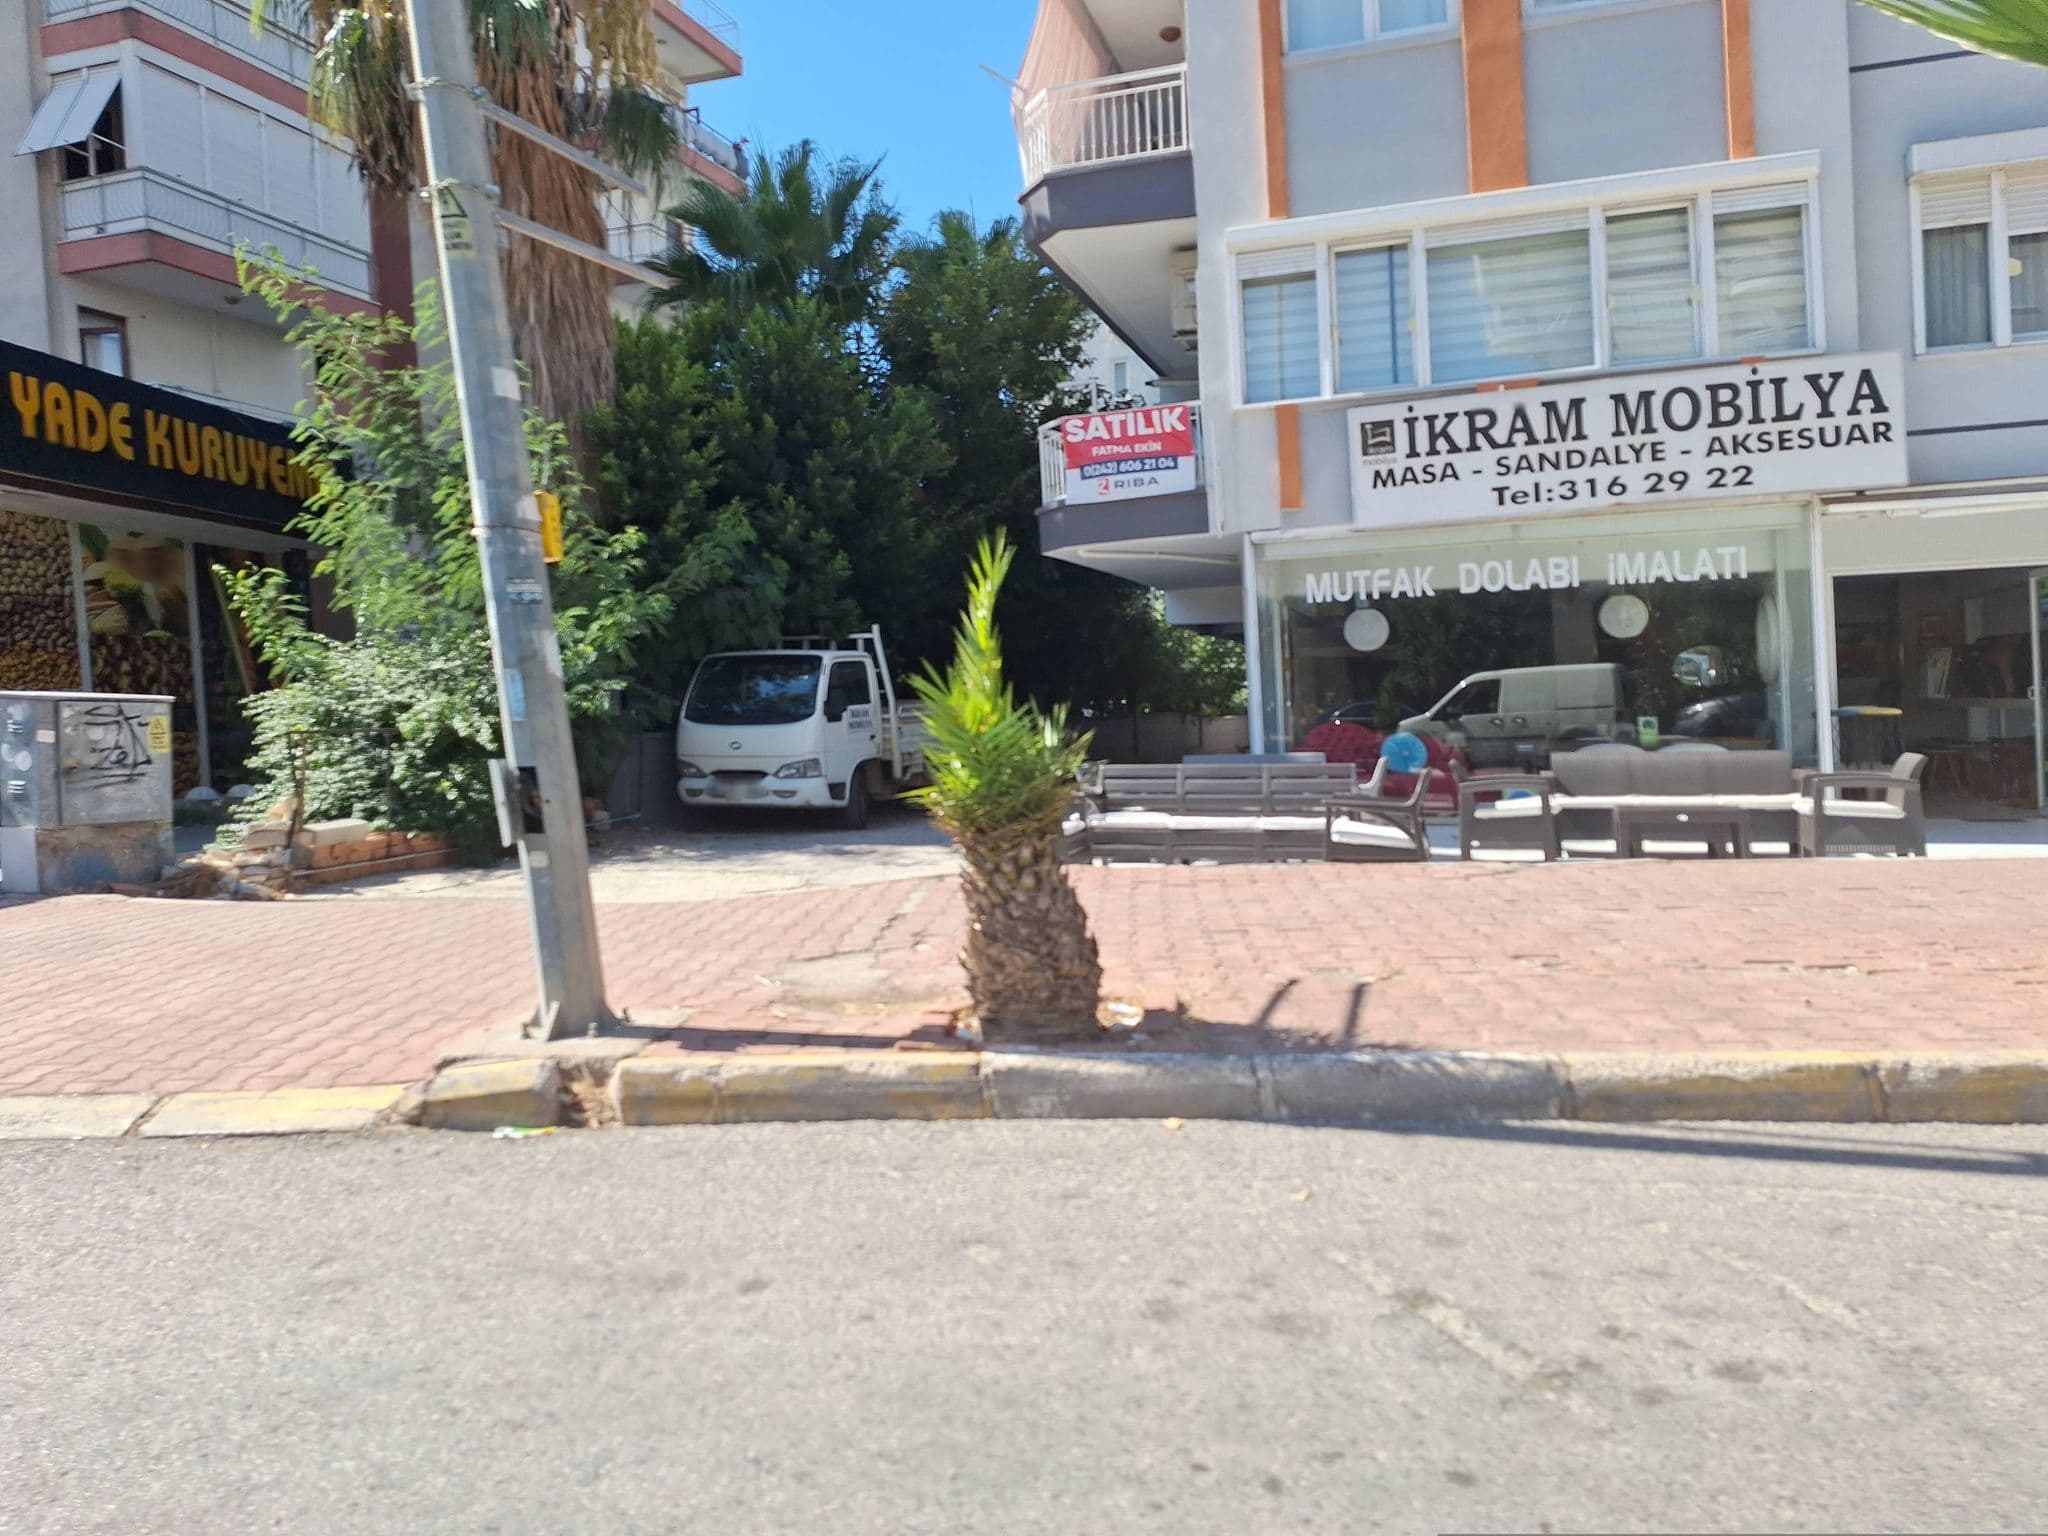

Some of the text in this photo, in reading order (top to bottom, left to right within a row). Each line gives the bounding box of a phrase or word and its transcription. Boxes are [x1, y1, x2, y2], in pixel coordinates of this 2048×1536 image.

[9, 371, 135, 460] YADE
[1065, 407, 1186, 443] SATILIK
[1403, 367, 1889, 459] İKRAM MOBİLYA
[1092, 444, 1132, 457] FATMA
[1372, 462, 1460, 489] MASA
[1496, 441, 1666, 476] SANDALYE
[1705, 421, 1894, 458] AKSESUAR
[1492, 465, 1754, 506] Tel:316 29 22
[1305, 566, 1435, 603] MUTFAK
[1458, 556, 1580, 594] DOLABI
